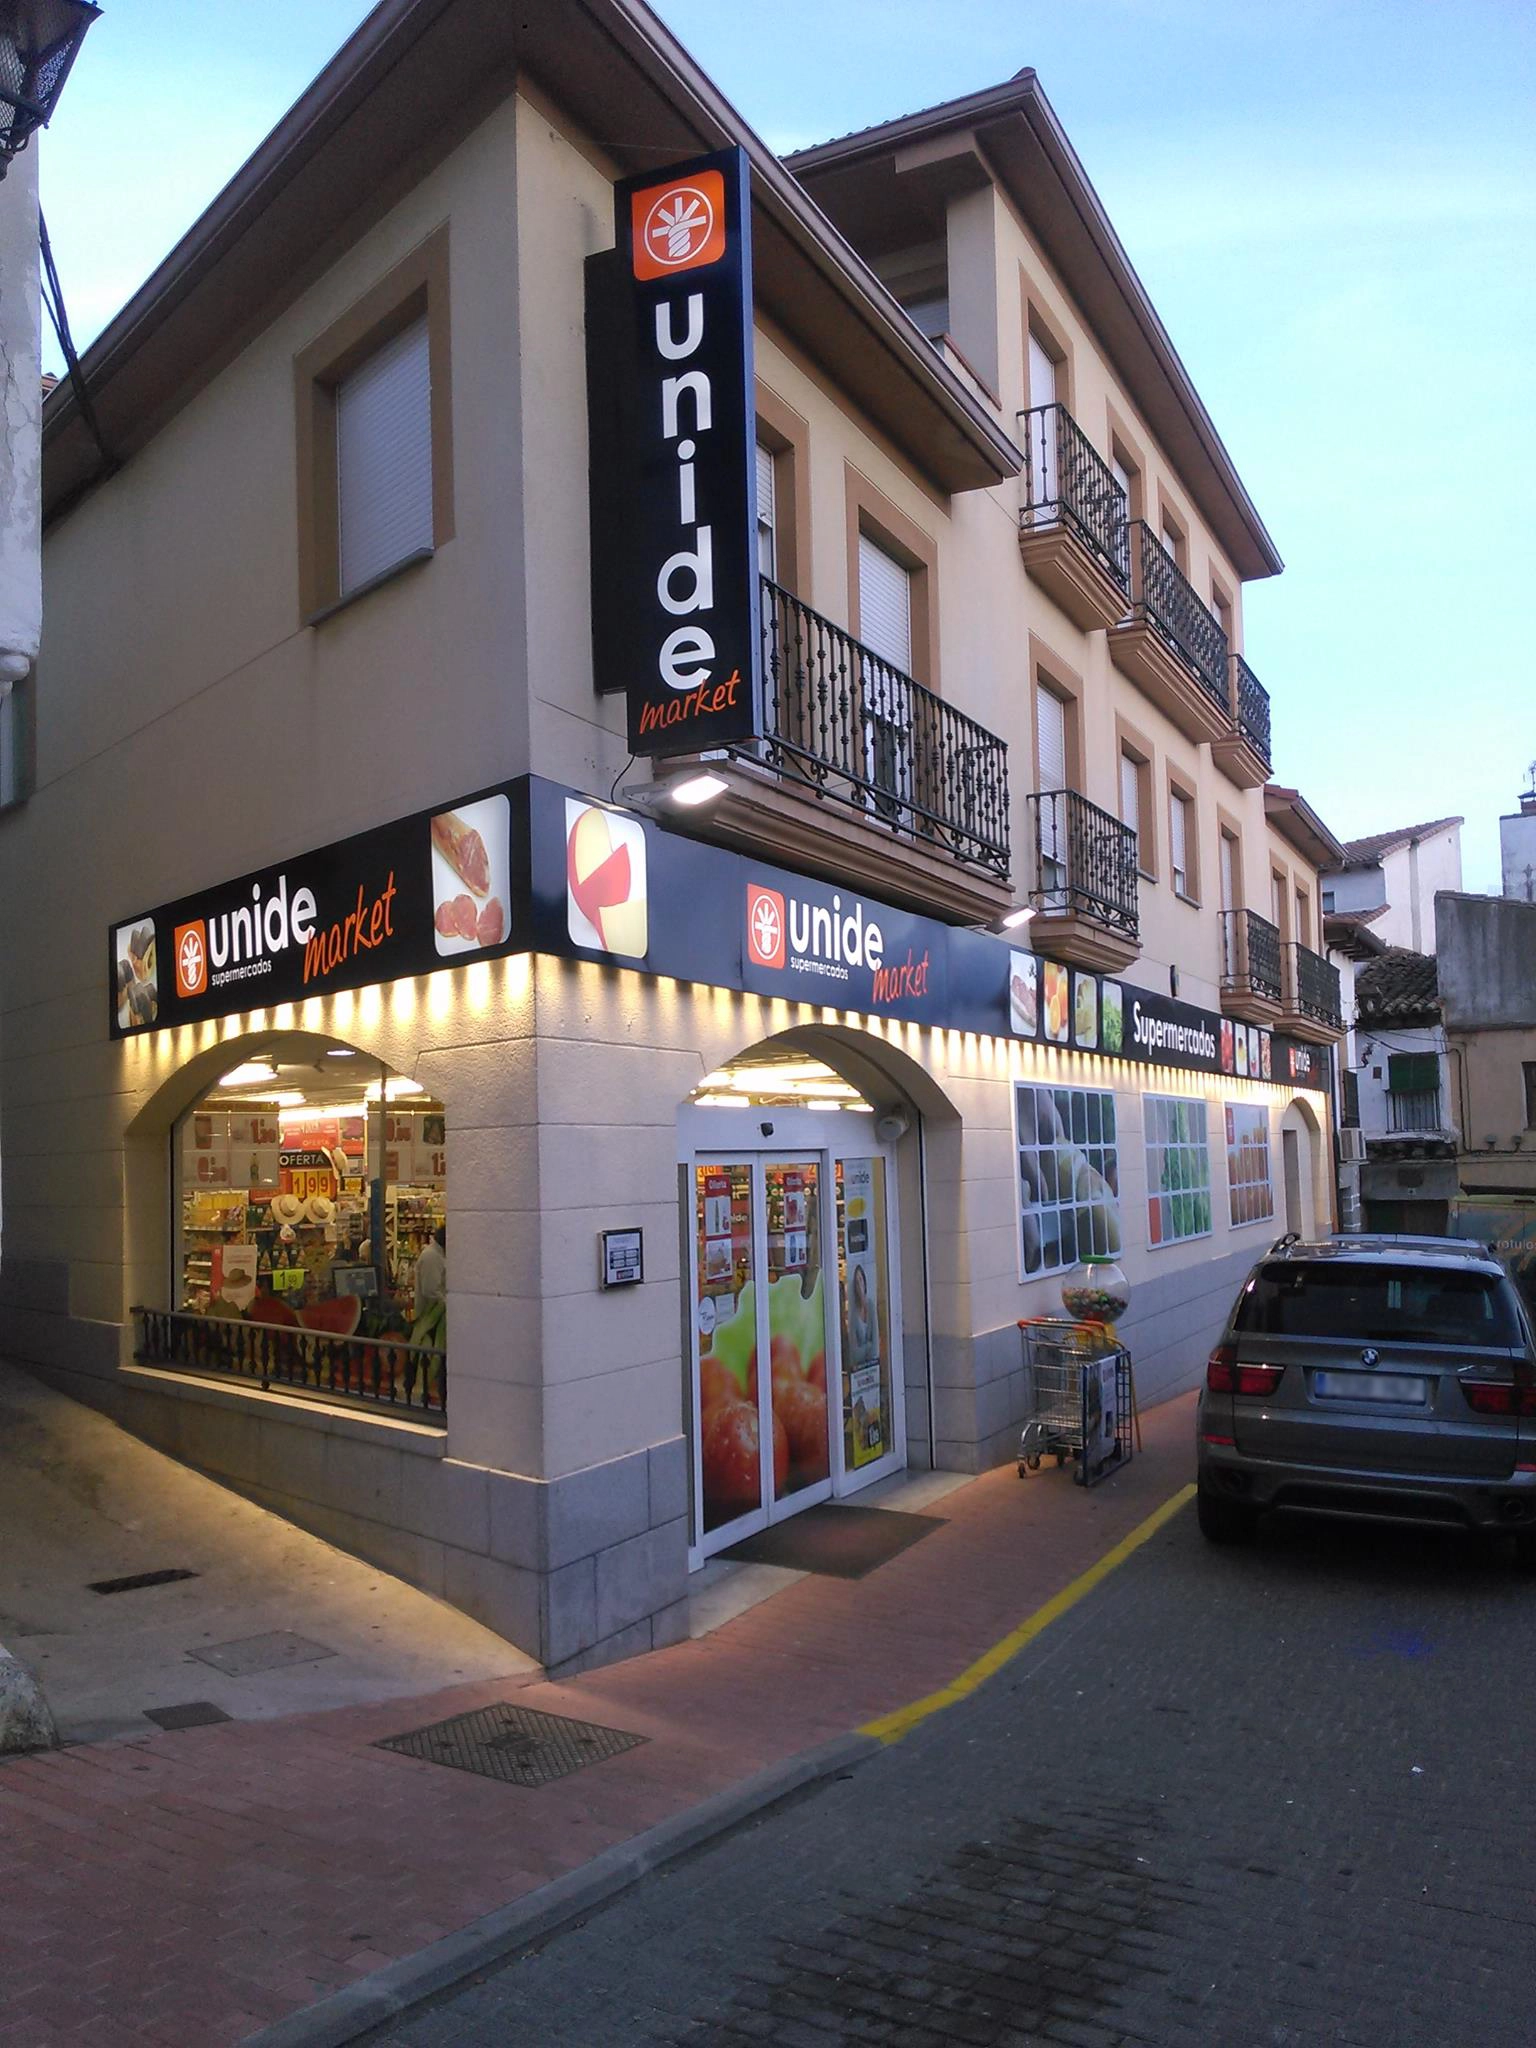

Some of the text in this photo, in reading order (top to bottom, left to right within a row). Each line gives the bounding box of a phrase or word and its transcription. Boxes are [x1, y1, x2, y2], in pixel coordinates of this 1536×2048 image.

[655, 293, 716, 691] unide
[639, 668, 742, 735] market
[209, 874, 318, 968] unide
[303, 870, 397, 984] market
[789, 894, 884, 971] unide
[211, 958, 272, 986] supermercados
[790, 956, 849, 980] supermercados
[872, 948, 929, 1004] market
[1133, 1001, 1217, 1057] Supermercados
[279, 1153, 325, 1167] OFERTA
[1496, 1239, 1536, 1251] rotulo
